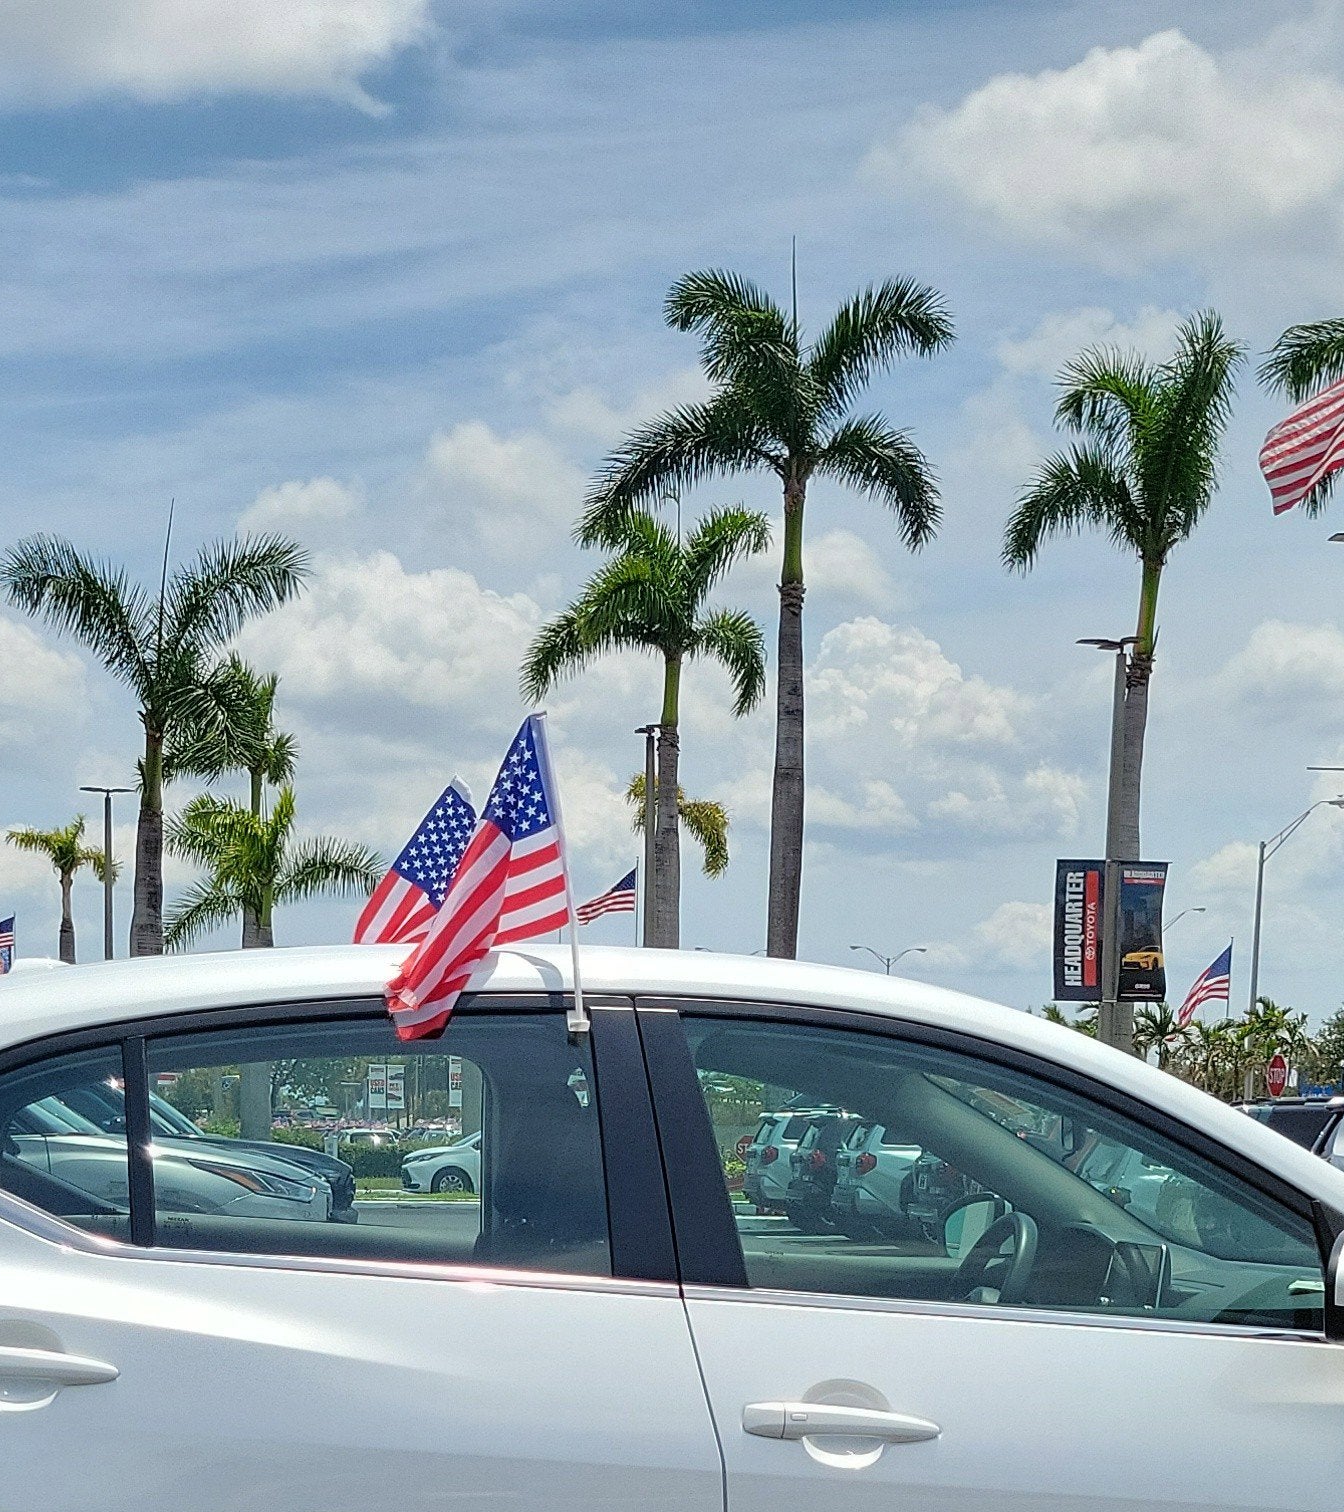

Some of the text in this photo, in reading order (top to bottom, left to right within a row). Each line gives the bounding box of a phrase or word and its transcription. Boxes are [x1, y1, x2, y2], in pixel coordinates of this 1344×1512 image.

[1064, 872, 1084, 987] HEADQUARTER
[1086, 902, 1097, 945] TOYOTA
[1269, 1068, 1285, 1084] STOP
[737, 1143, 749, 1154] ST
